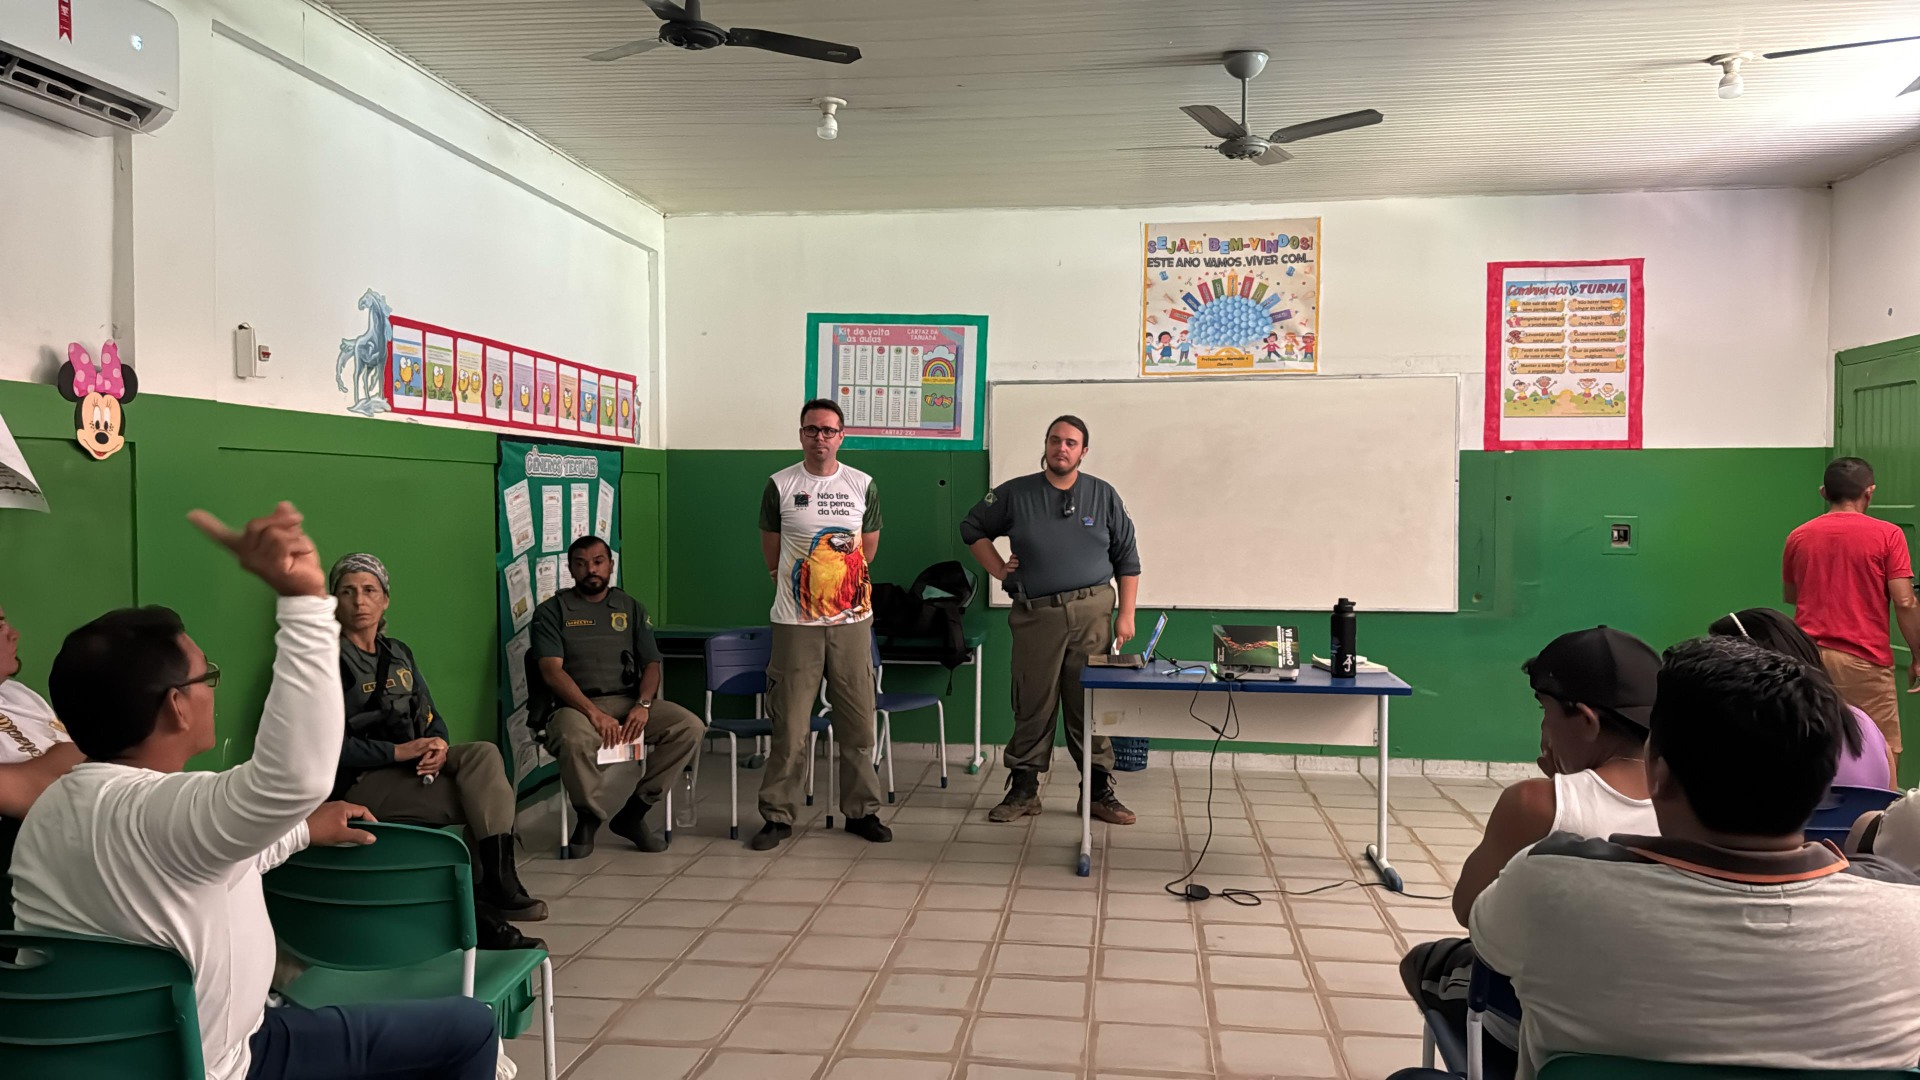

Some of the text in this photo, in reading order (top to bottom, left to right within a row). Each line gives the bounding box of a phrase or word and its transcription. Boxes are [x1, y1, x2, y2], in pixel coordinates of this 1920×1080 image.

[1147, 233, 1314, 254] SEJAM BEM-VINDOS!
[1147, 257, 1174, 268] ESTE
[1175, 257, 1200, 267] ANO
[1203, 257, 1242, 268] VAMOS
[1245, 254, 1278, 267] VIVER
[1506, 282, 1626, 296] Combinados da TURMA
[838, 327, 890, 337] Kit de volta
[859, 335, 881, 343] aulas
[526, 448, 597, 476] GÊNEROS TEXTUAIS
[817, 492, 849, 500] Não tire
[830, 501, 856, 509] penas
[817, 508, 850, 516] da vida
